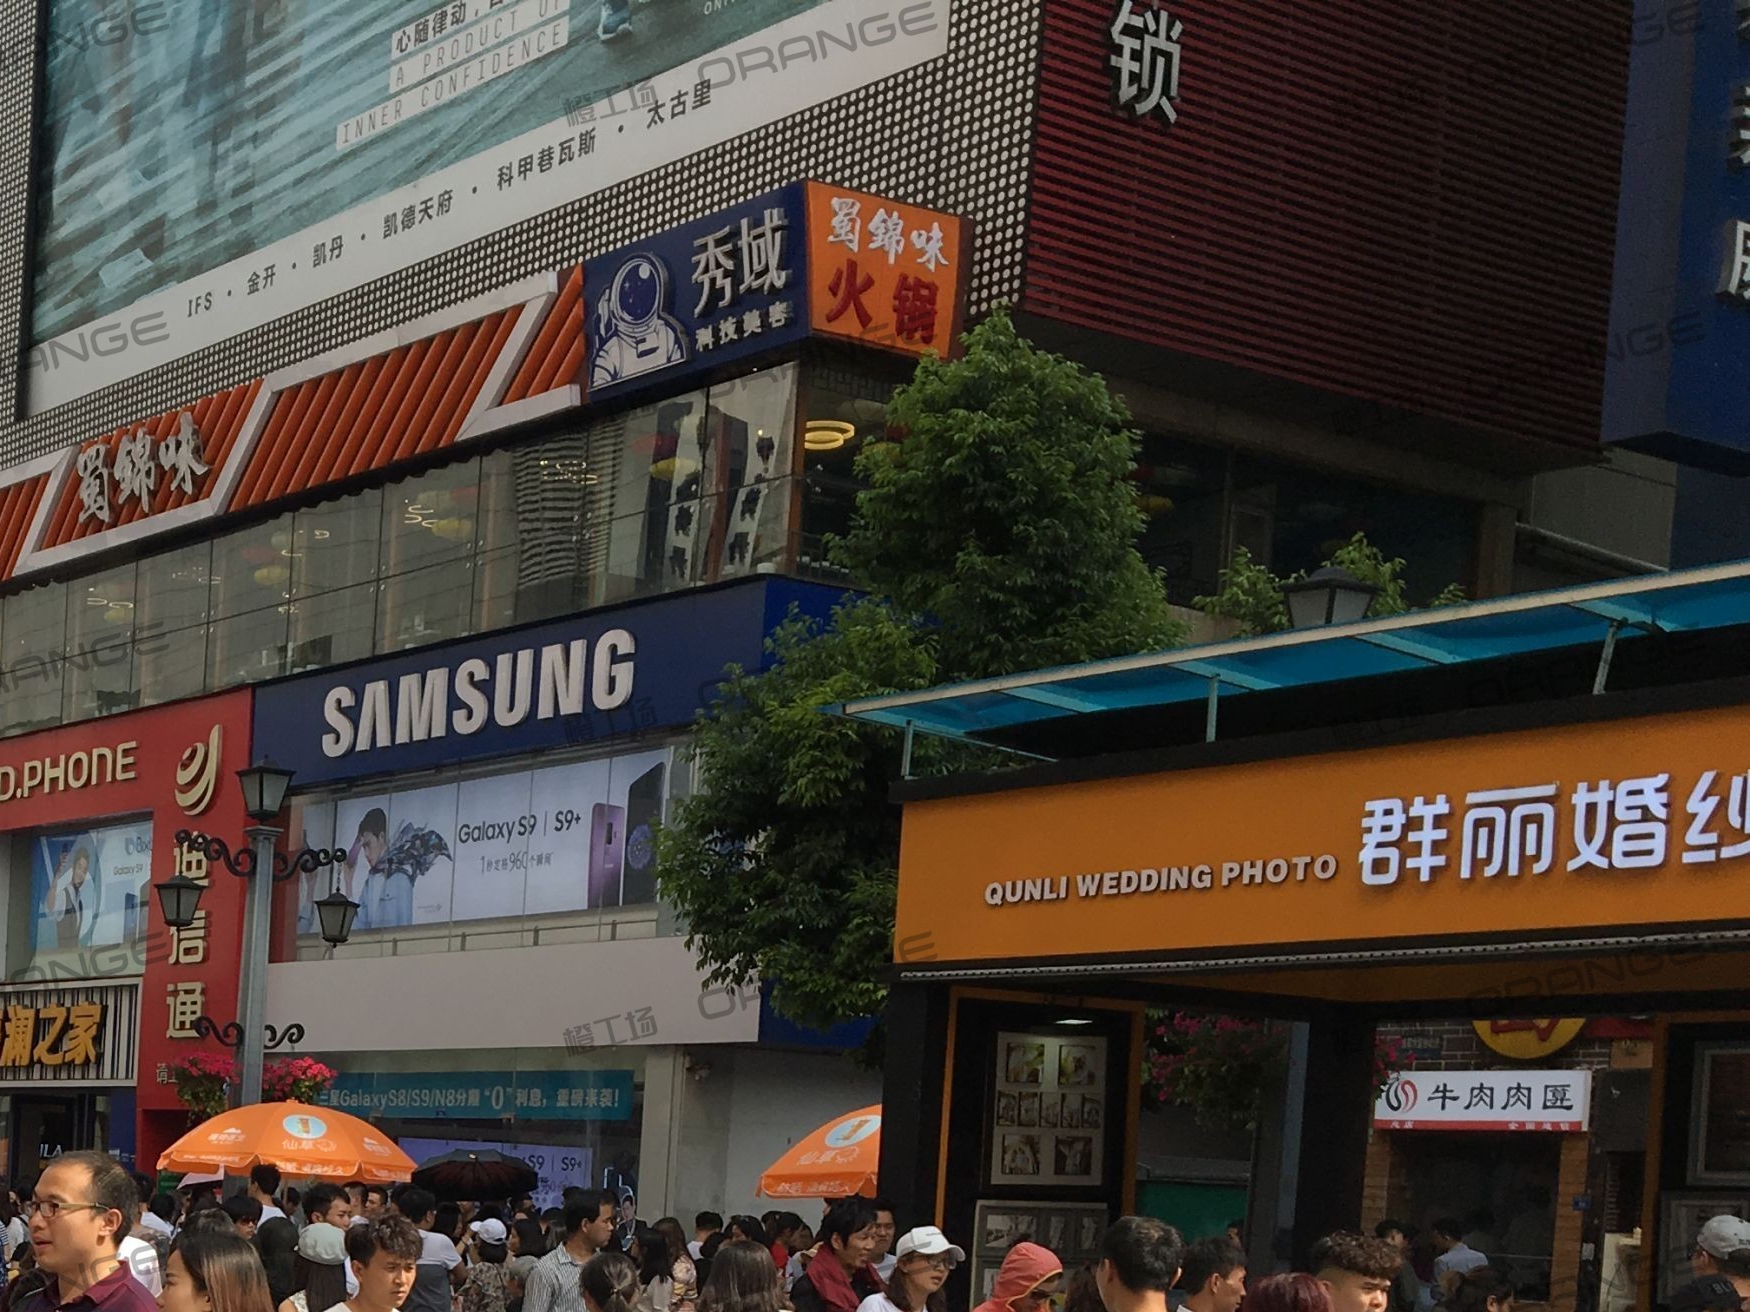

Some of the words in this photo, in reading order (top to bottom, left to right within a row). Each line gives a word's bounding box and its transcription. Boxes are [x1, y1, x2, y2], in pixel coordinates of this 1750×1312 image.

[342, 100, 402, 144] INNER
[421, 24, 561, 107] CONFIDENCE
[396, 66, 404, 87] A
[423, 10, 517, 73] PRODUCT
[188, 292, 212, 318] IFS
[247, 264, 275, 296] 金开
[312, 236, 342, 268] 凯丹
[382, 189, 453, 239] 凯德天府
[497, 127, 596, 191] 科甲巷瓦斯
[646, 79, 711, 130] 太古里
[691, 208, 791, 319] 秀域
[826, 259, 938, 344] 火锅
[321, 628, 637, 758] SAMSUNG
[457, 820, 516, 844] Galaxy
[516, 814, 537, 837] S9
[553, 809, 582, 832] S9+
[984, 877, 1069, 906] QUNLI
[1077, 865, 1212, 896] WEDDING
[1221, 854, 1338, 886] PHOTO
